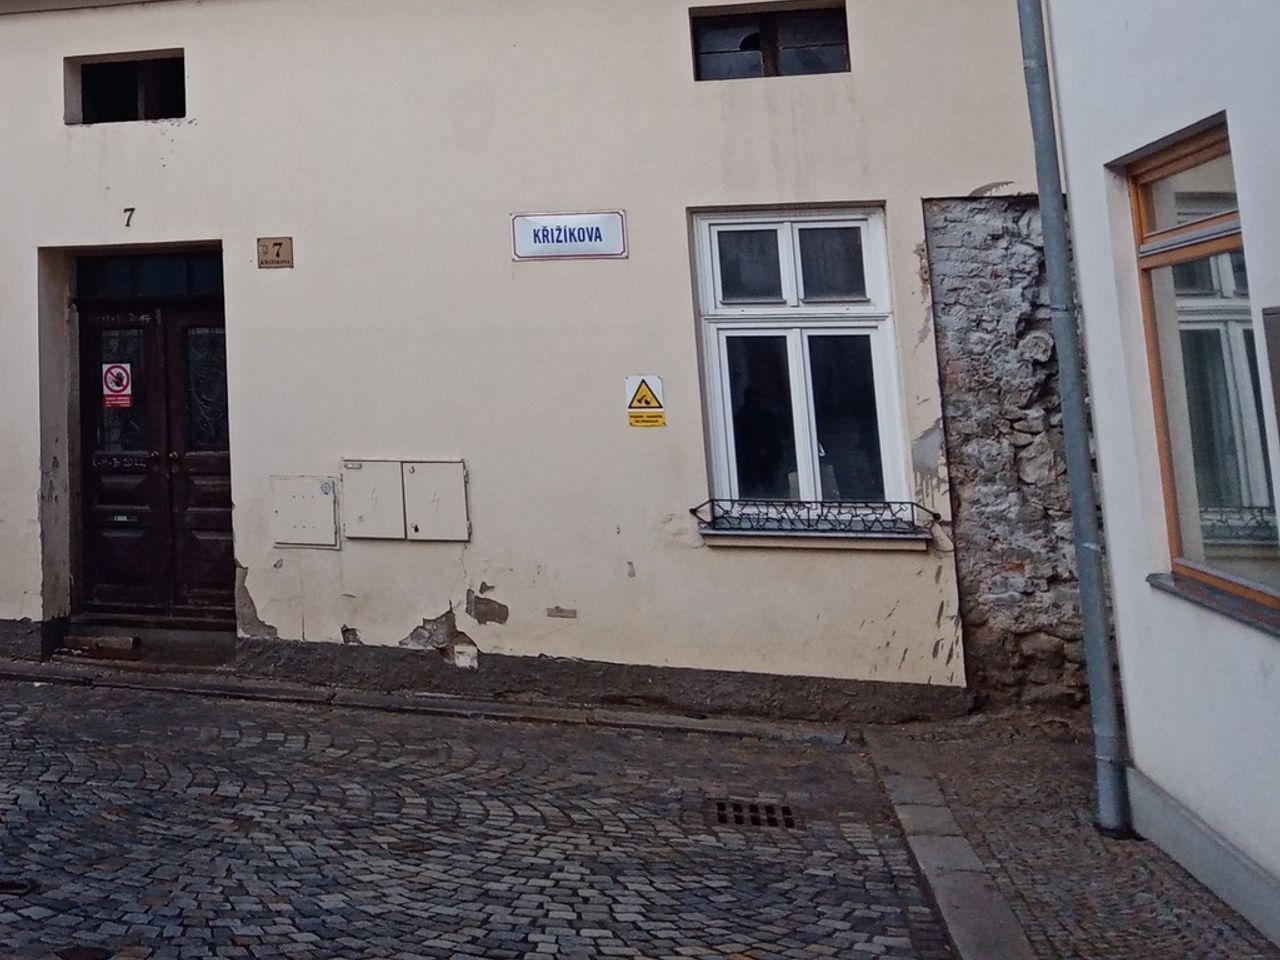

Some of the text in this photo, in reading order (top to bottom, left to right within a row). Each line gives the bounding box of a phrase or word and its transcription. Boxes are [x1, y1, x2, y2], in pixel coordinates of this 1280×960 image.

[123, 207, 136, 227] 7
[533, 225, 603, 244] KŘIŽÍKOVA
[272, 242, 283, 258] 7
